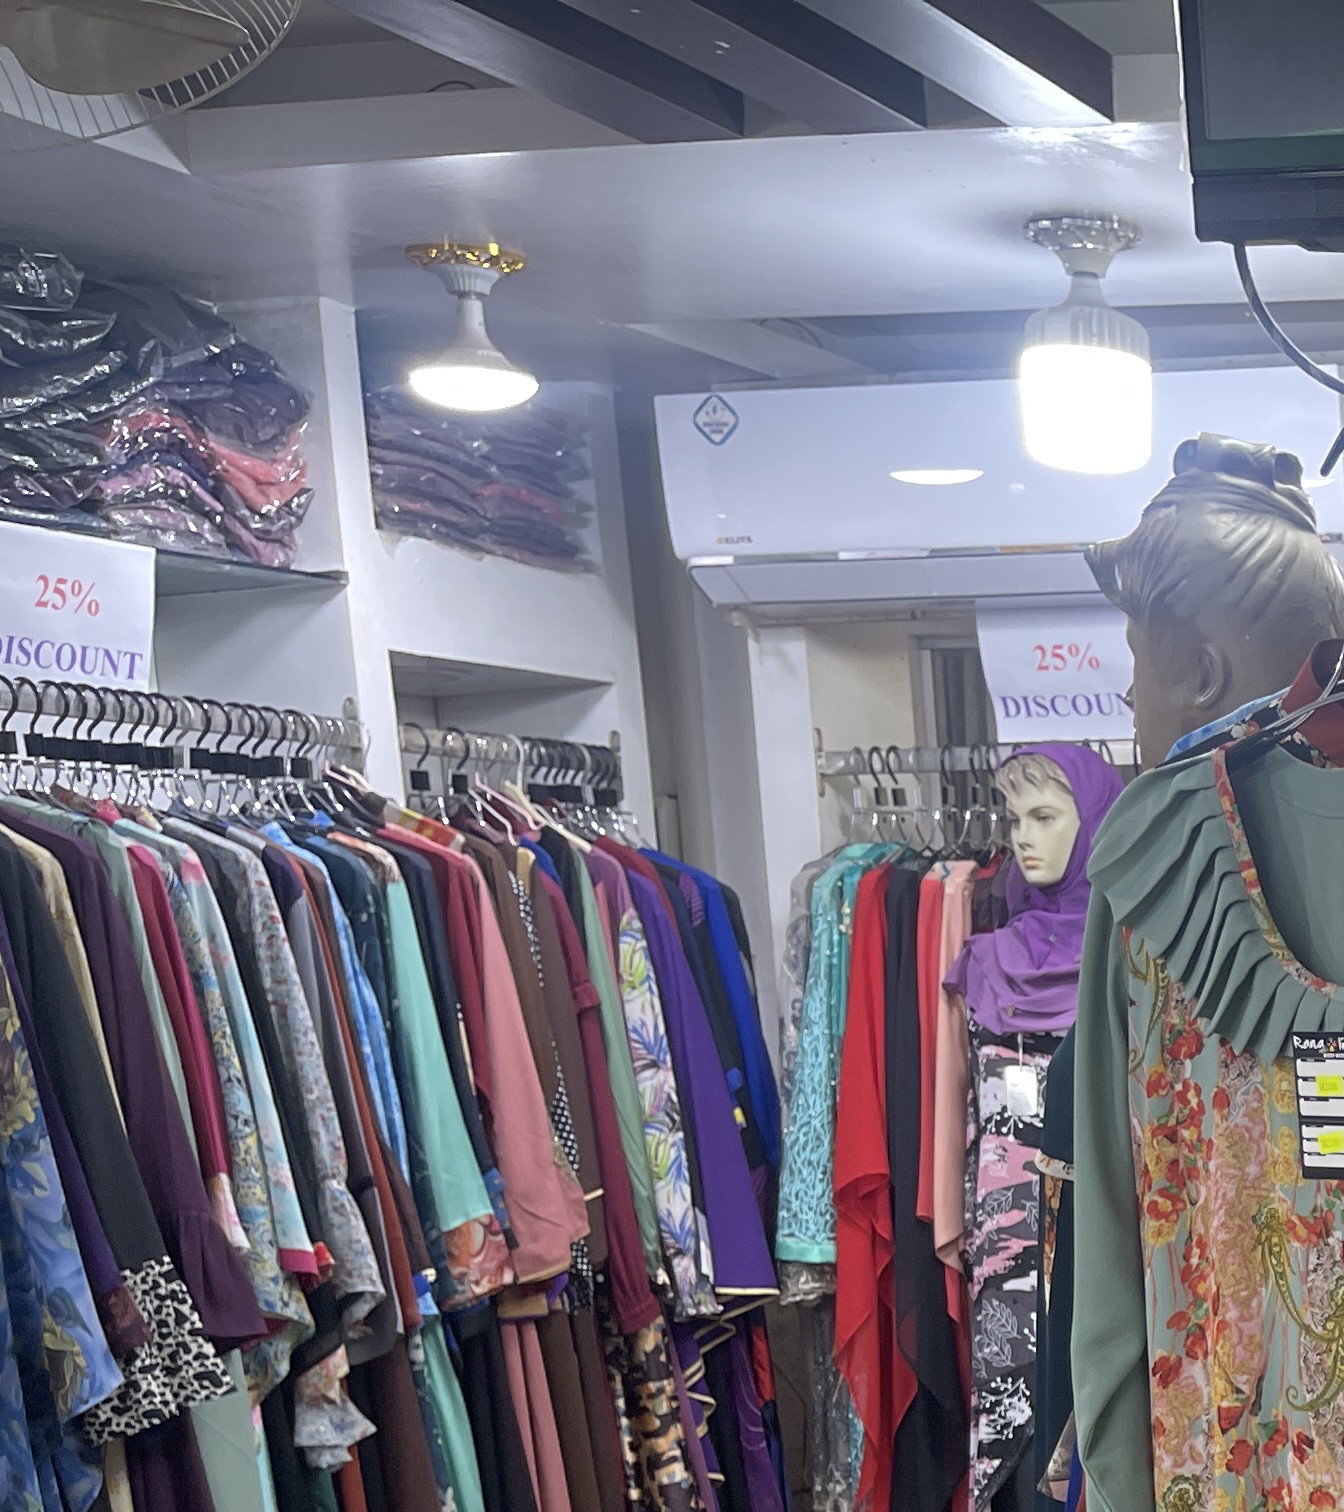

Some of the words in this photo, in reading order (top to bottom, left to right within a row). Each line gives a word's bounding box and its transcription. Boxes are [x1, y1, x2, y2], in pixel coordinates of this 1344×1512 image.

[34, 574, 100, 617] 25%
[0, 635, 143, 680] ISCOUNT
[1032, 642, 1100, 671] 25%
